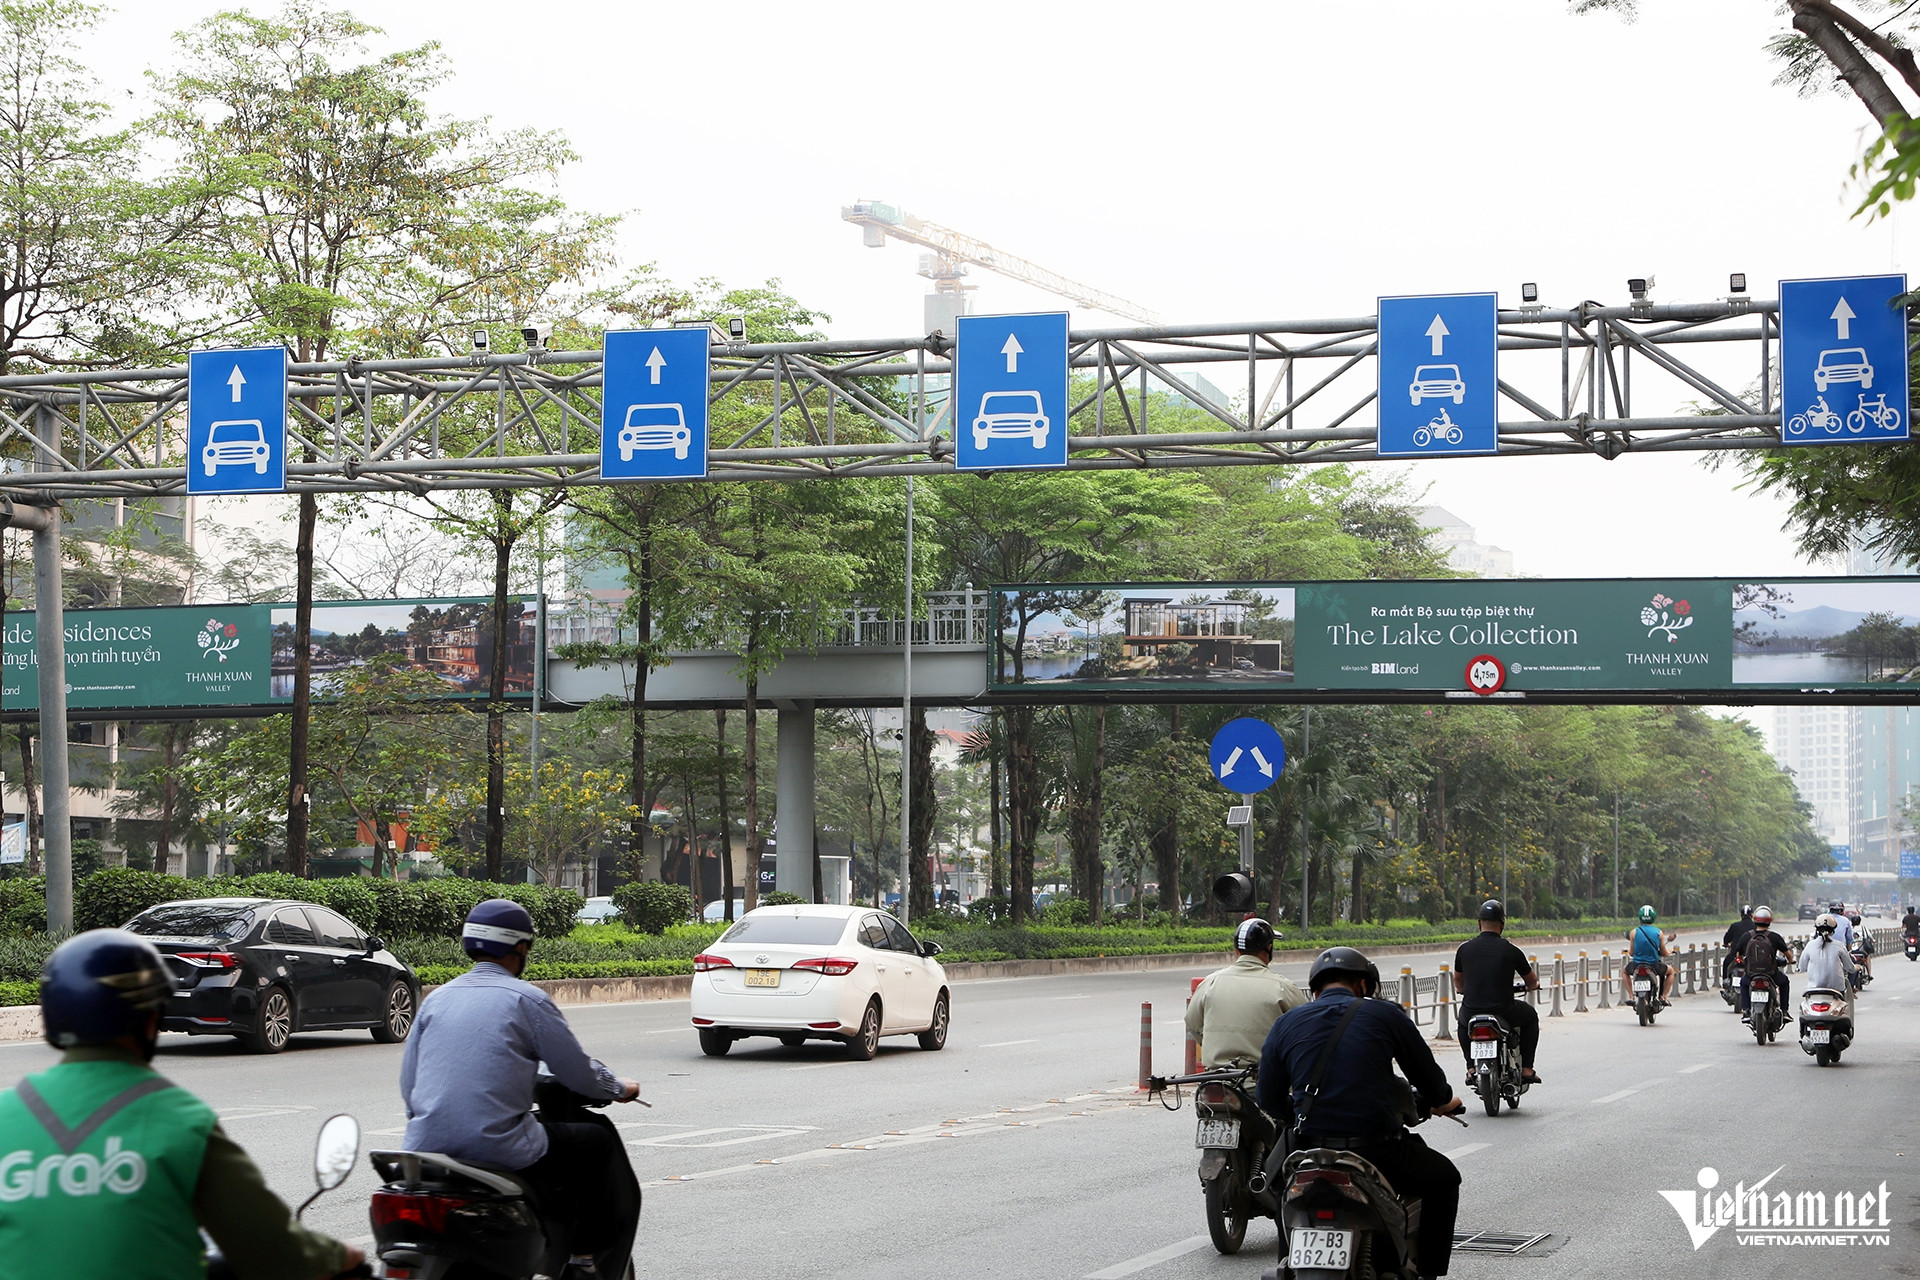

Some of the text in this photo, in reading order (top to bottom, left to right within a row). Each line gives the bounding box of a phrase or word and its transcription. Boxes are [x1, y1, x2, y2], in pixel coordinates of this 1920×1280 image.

[1371, 604, 1535, 619] Ra mắt Bộ sưu tập biệt thự
[3, 621, 152, 644] ide sidences
[1327, 622, 1579, 645] The Lake Collection
[92, 646, 118, 663] tinh
[1625, 653, 1709, 664] THANH XUAN
[185, 671, 252, 682] THANH XUAN
[1474, 668, 1496, 683] 4,75m
[1650, 668, 1682, 676] VALLEY
[0, 1136, 147, 1202] Grab
[1302, 1231, 1344, 1249] 17-B3
[1293, 1249, 1348, 1267] 362.43
